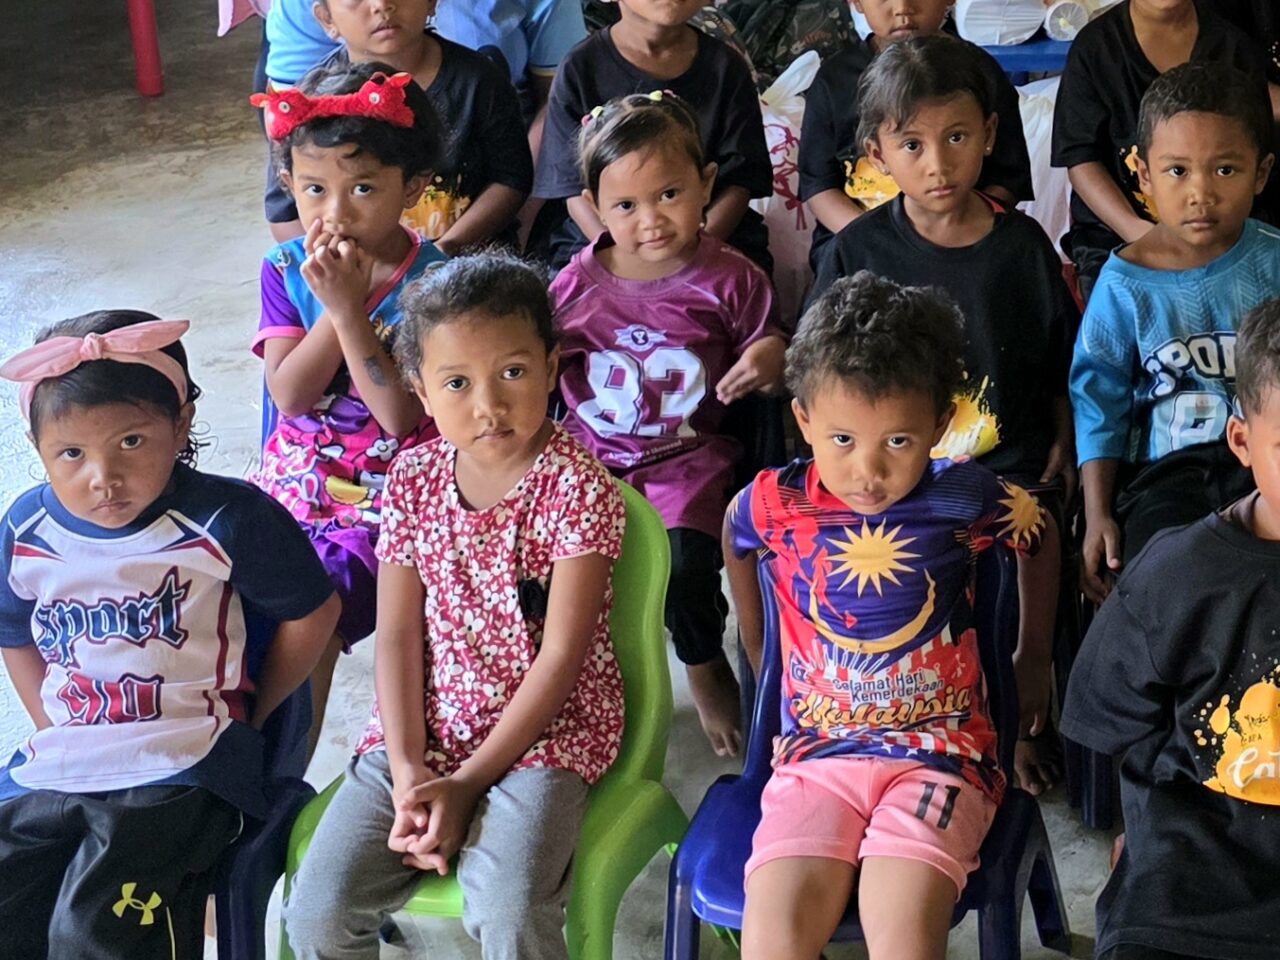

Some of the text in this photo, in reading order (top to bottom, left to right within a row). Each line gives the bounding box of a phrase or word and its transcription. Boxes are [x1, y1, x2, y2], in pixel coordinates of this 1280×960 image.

[832, 669, 925, 691] Selamat Hari
[852, 679, 945, 704] Kemerdekaan
